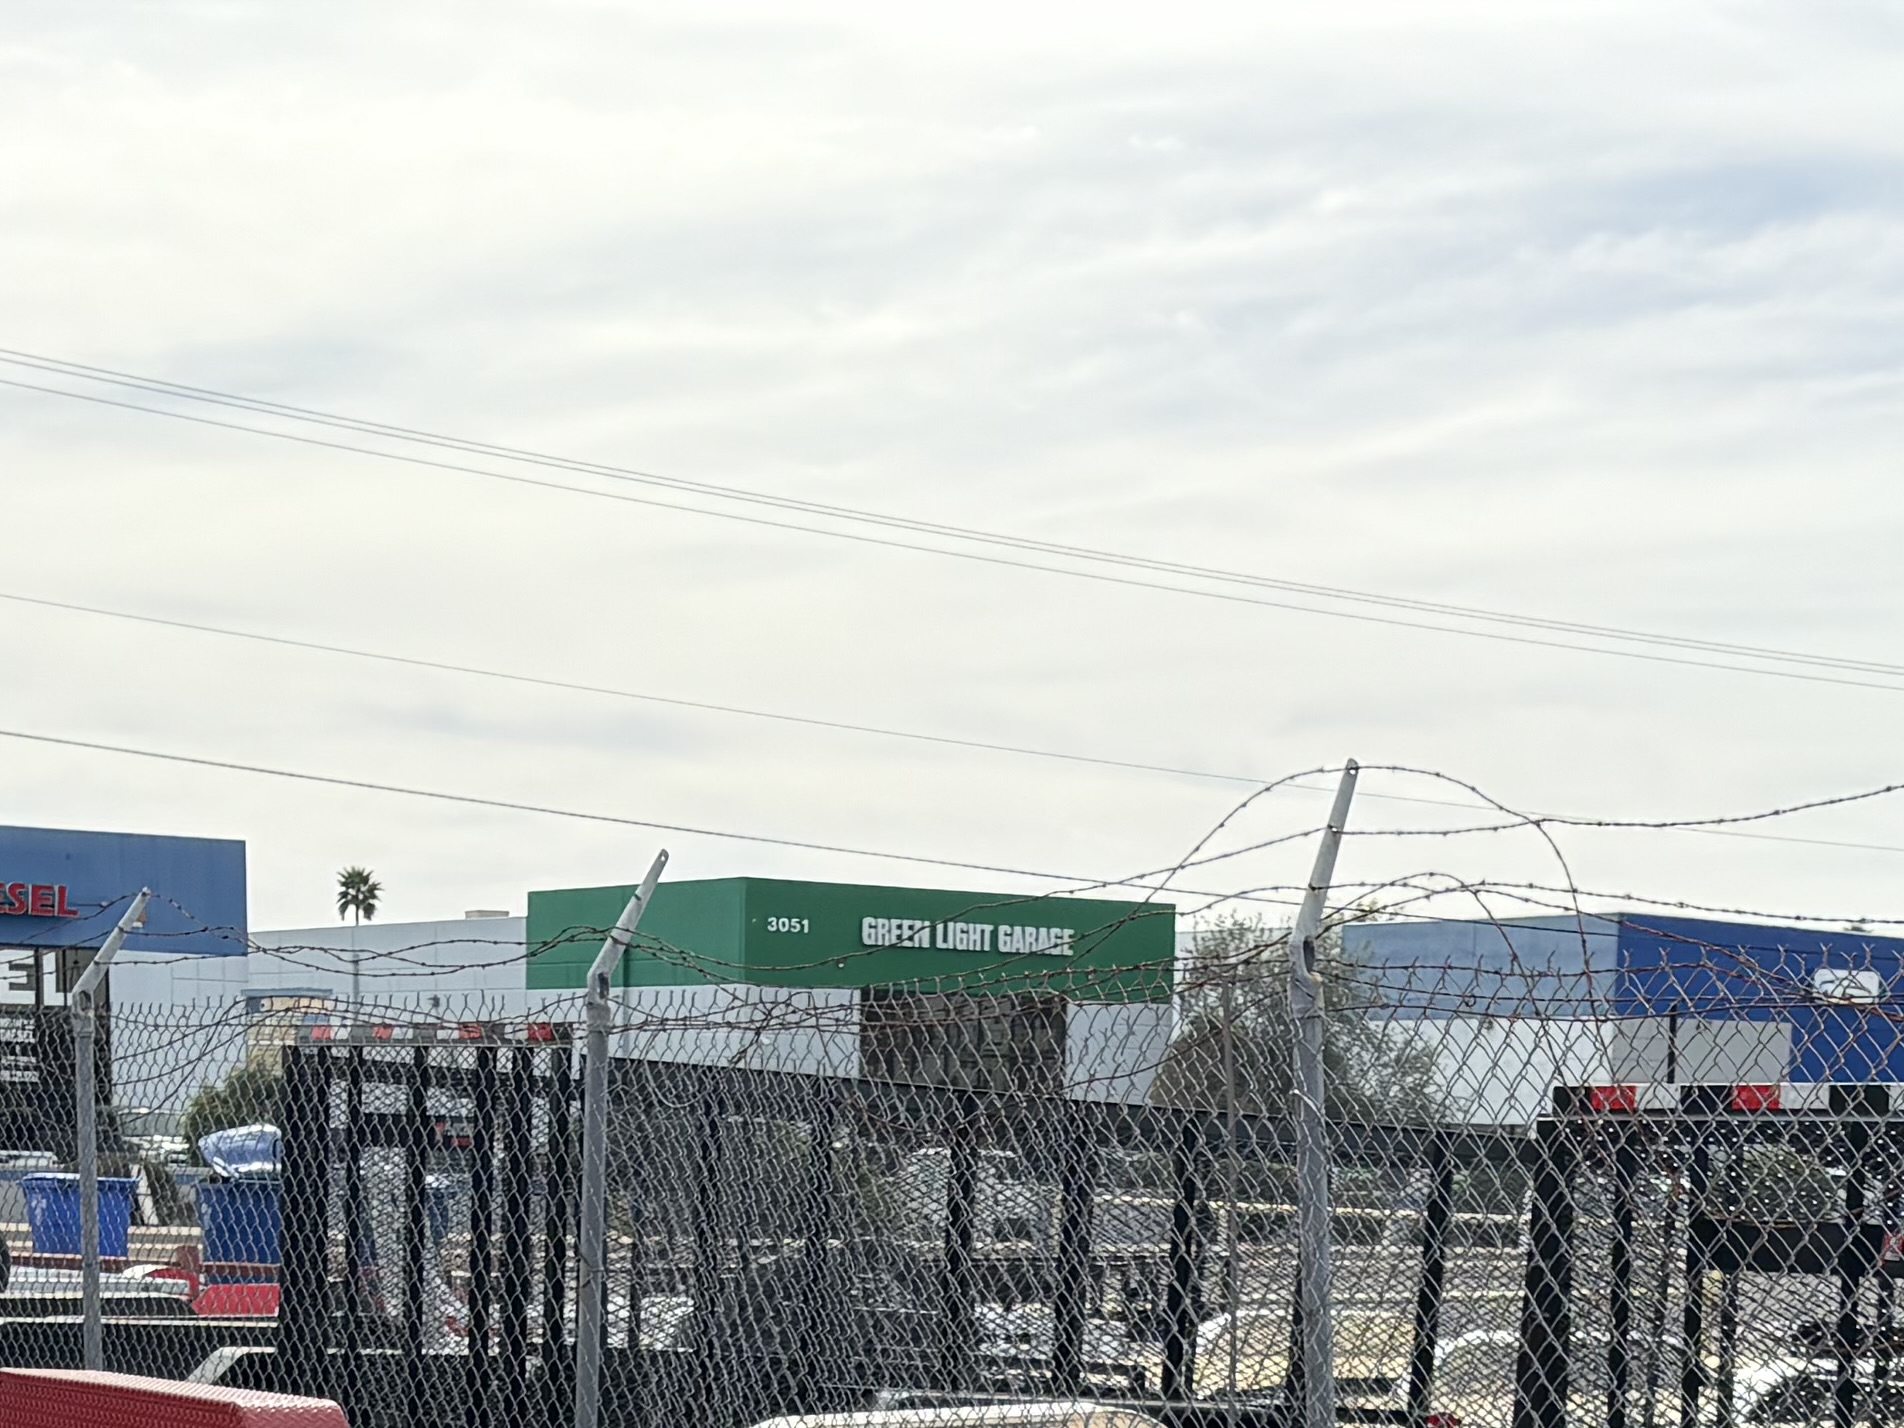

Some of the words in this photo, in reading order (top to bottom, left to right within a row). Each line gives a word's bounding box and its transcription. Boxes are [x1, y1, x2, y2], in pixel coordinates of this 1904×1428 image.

[767, 916, 810, 934] 3051
[861, 916, 931, 948] GREEN
[935, 920, 995, 952] LIGHT
[997, 924, 1075, 956] GARAGE
